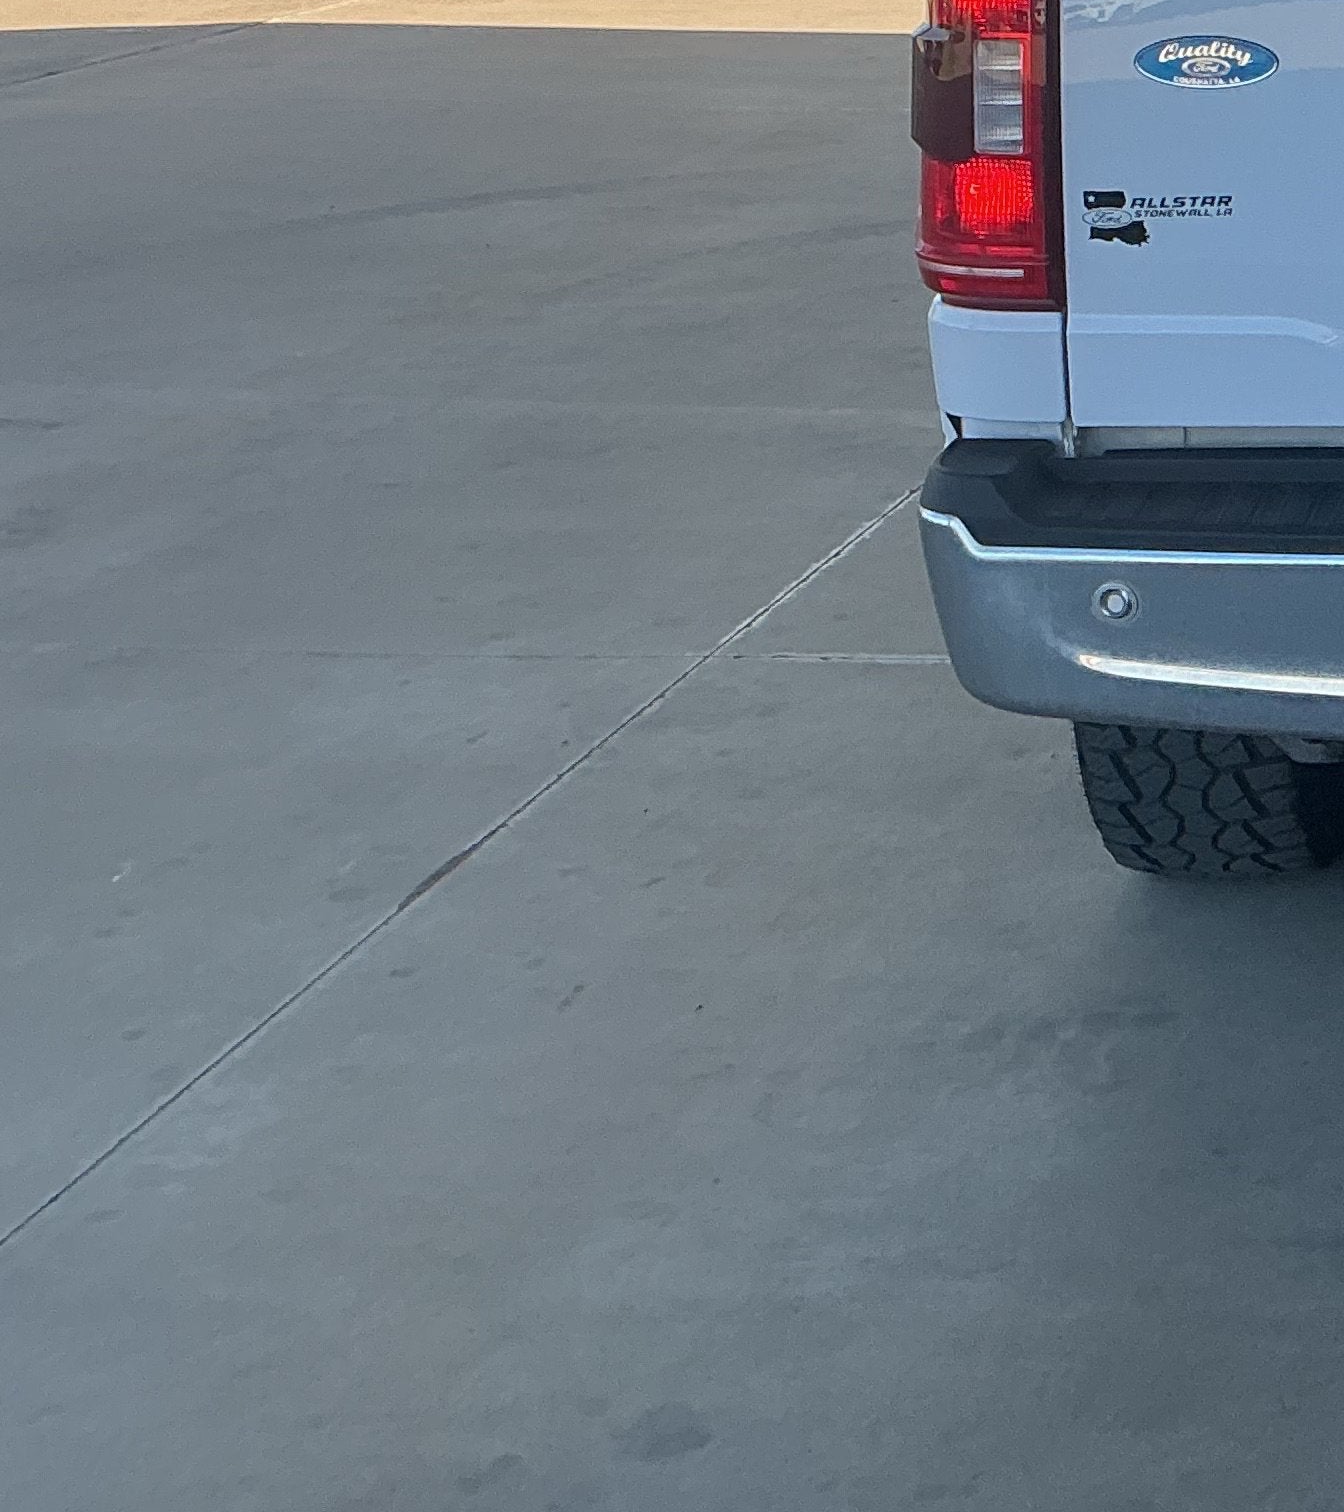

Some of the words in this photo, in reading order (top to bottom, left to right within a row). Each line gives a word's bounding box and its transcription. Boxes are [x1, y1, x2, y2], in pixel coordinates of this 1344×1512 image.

[1158, 41, 1253, 67] Quality
[1130, 196, 1233, 208] ALLSTAR
[1216, 208, 1233, 217] LA
